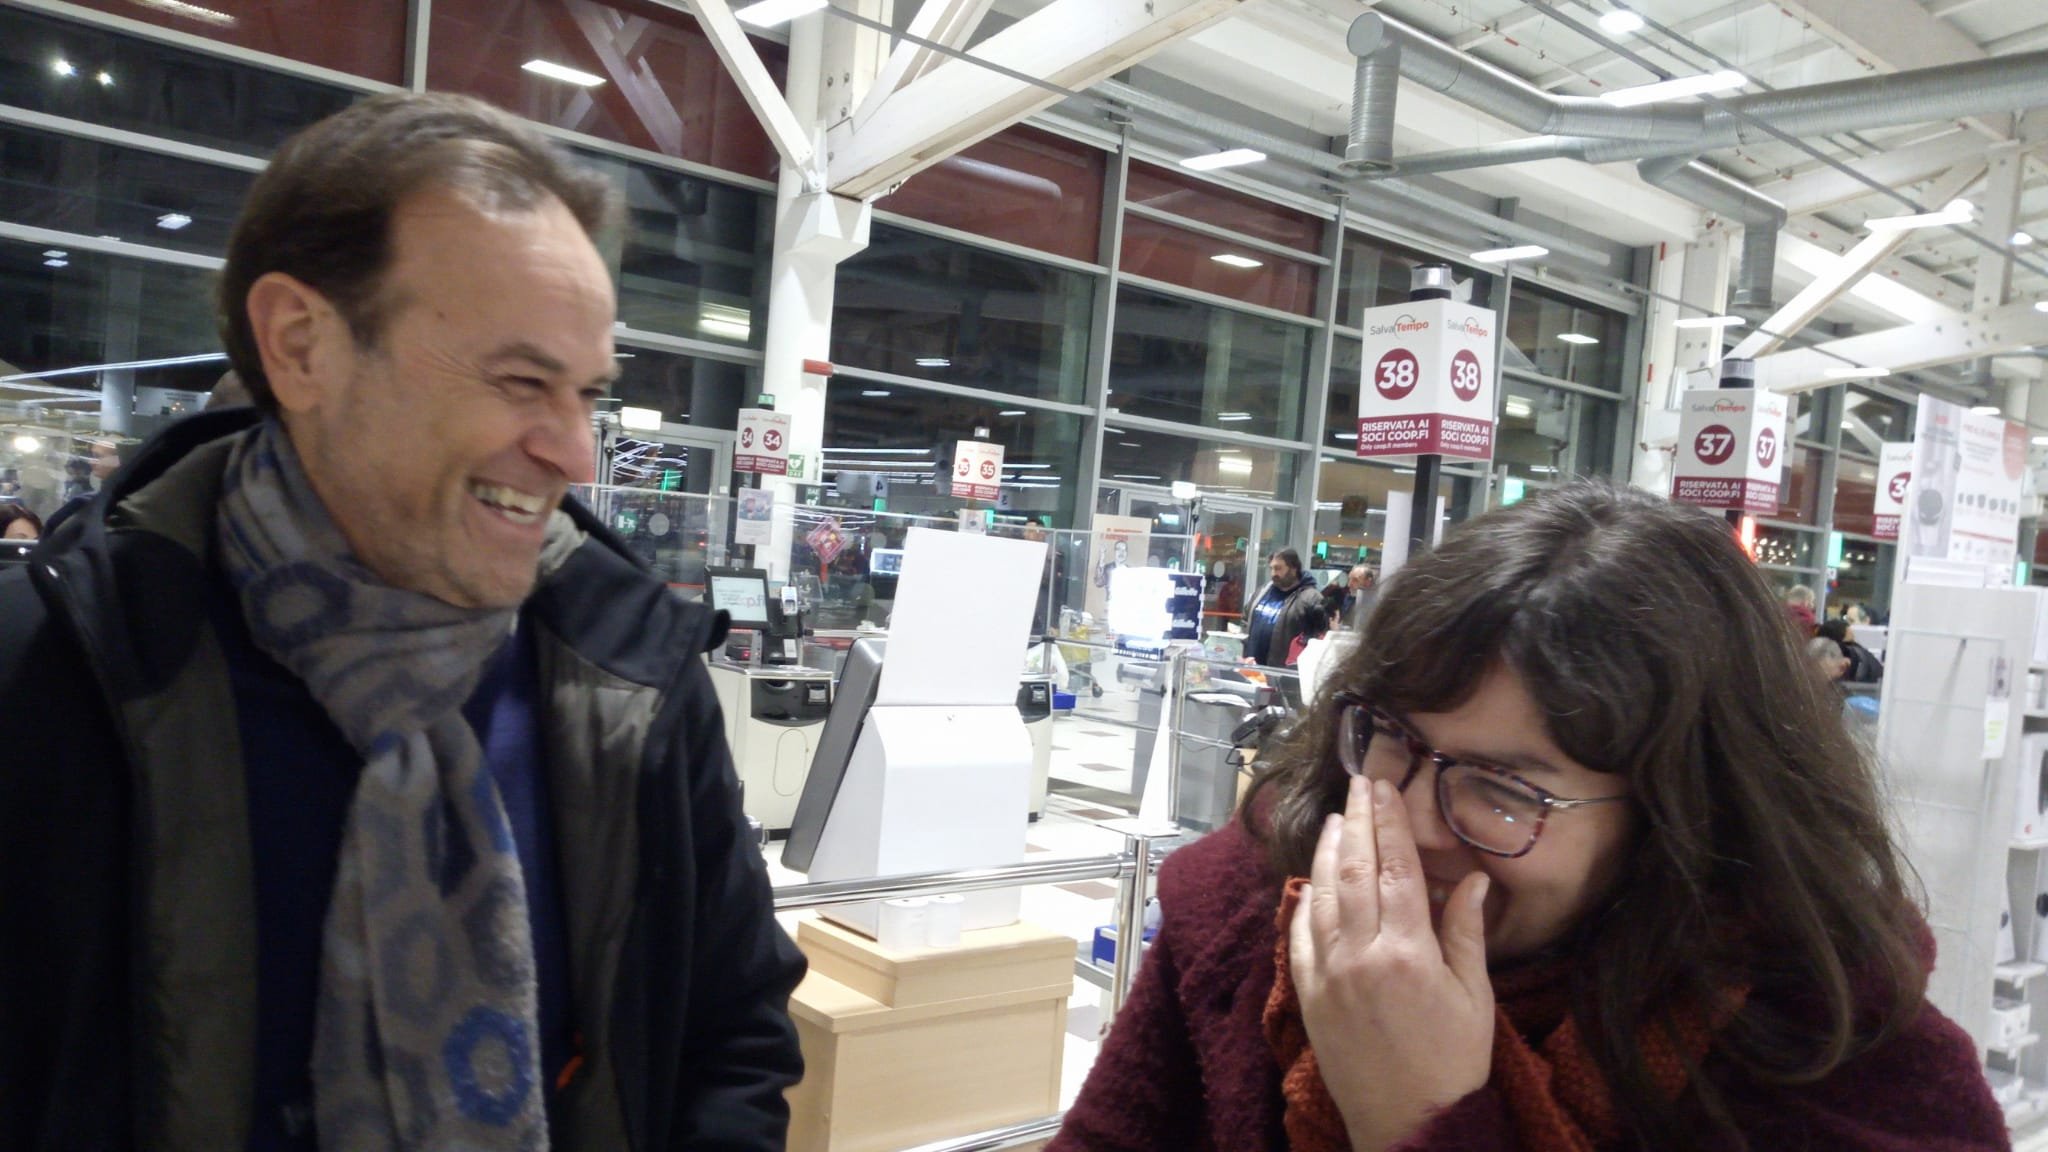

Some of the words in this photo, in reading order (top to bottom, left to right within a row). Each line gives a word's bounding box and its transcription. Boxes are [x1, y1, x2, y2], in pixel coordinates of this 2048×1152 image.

[1370, 318, 1429, 335] SalvaTempo
[1379, 359, 1414, 389] 38
[1453, 360, 1479, 391] 38
[1362, 420, 1416, 432] RISERVATA
[1418, 419, 1429, 429] AI
[1441, 419, 1480, 433] RISERVATA
[1481, 426, 1489, 435] AI
[764, 433, 781, 448] 34
[1361, 432, 1386, 442] SOCI
[1388, 429, 1429, 441] COOP.FI
[1441, 430, 1459, 441] SOCI
[1460, 433, 1489, 446] COOP.FI
[1698, 433, 1732, 456] 37
[1758, 436, 1775, 459] 37
[981, 463, 995, 476] 35
[1680, 480, 1728, 489] RISERVATA
[1679, 488, 1701, 497] SOCI
[1703, 490, 1741, 498] COOP.FI
